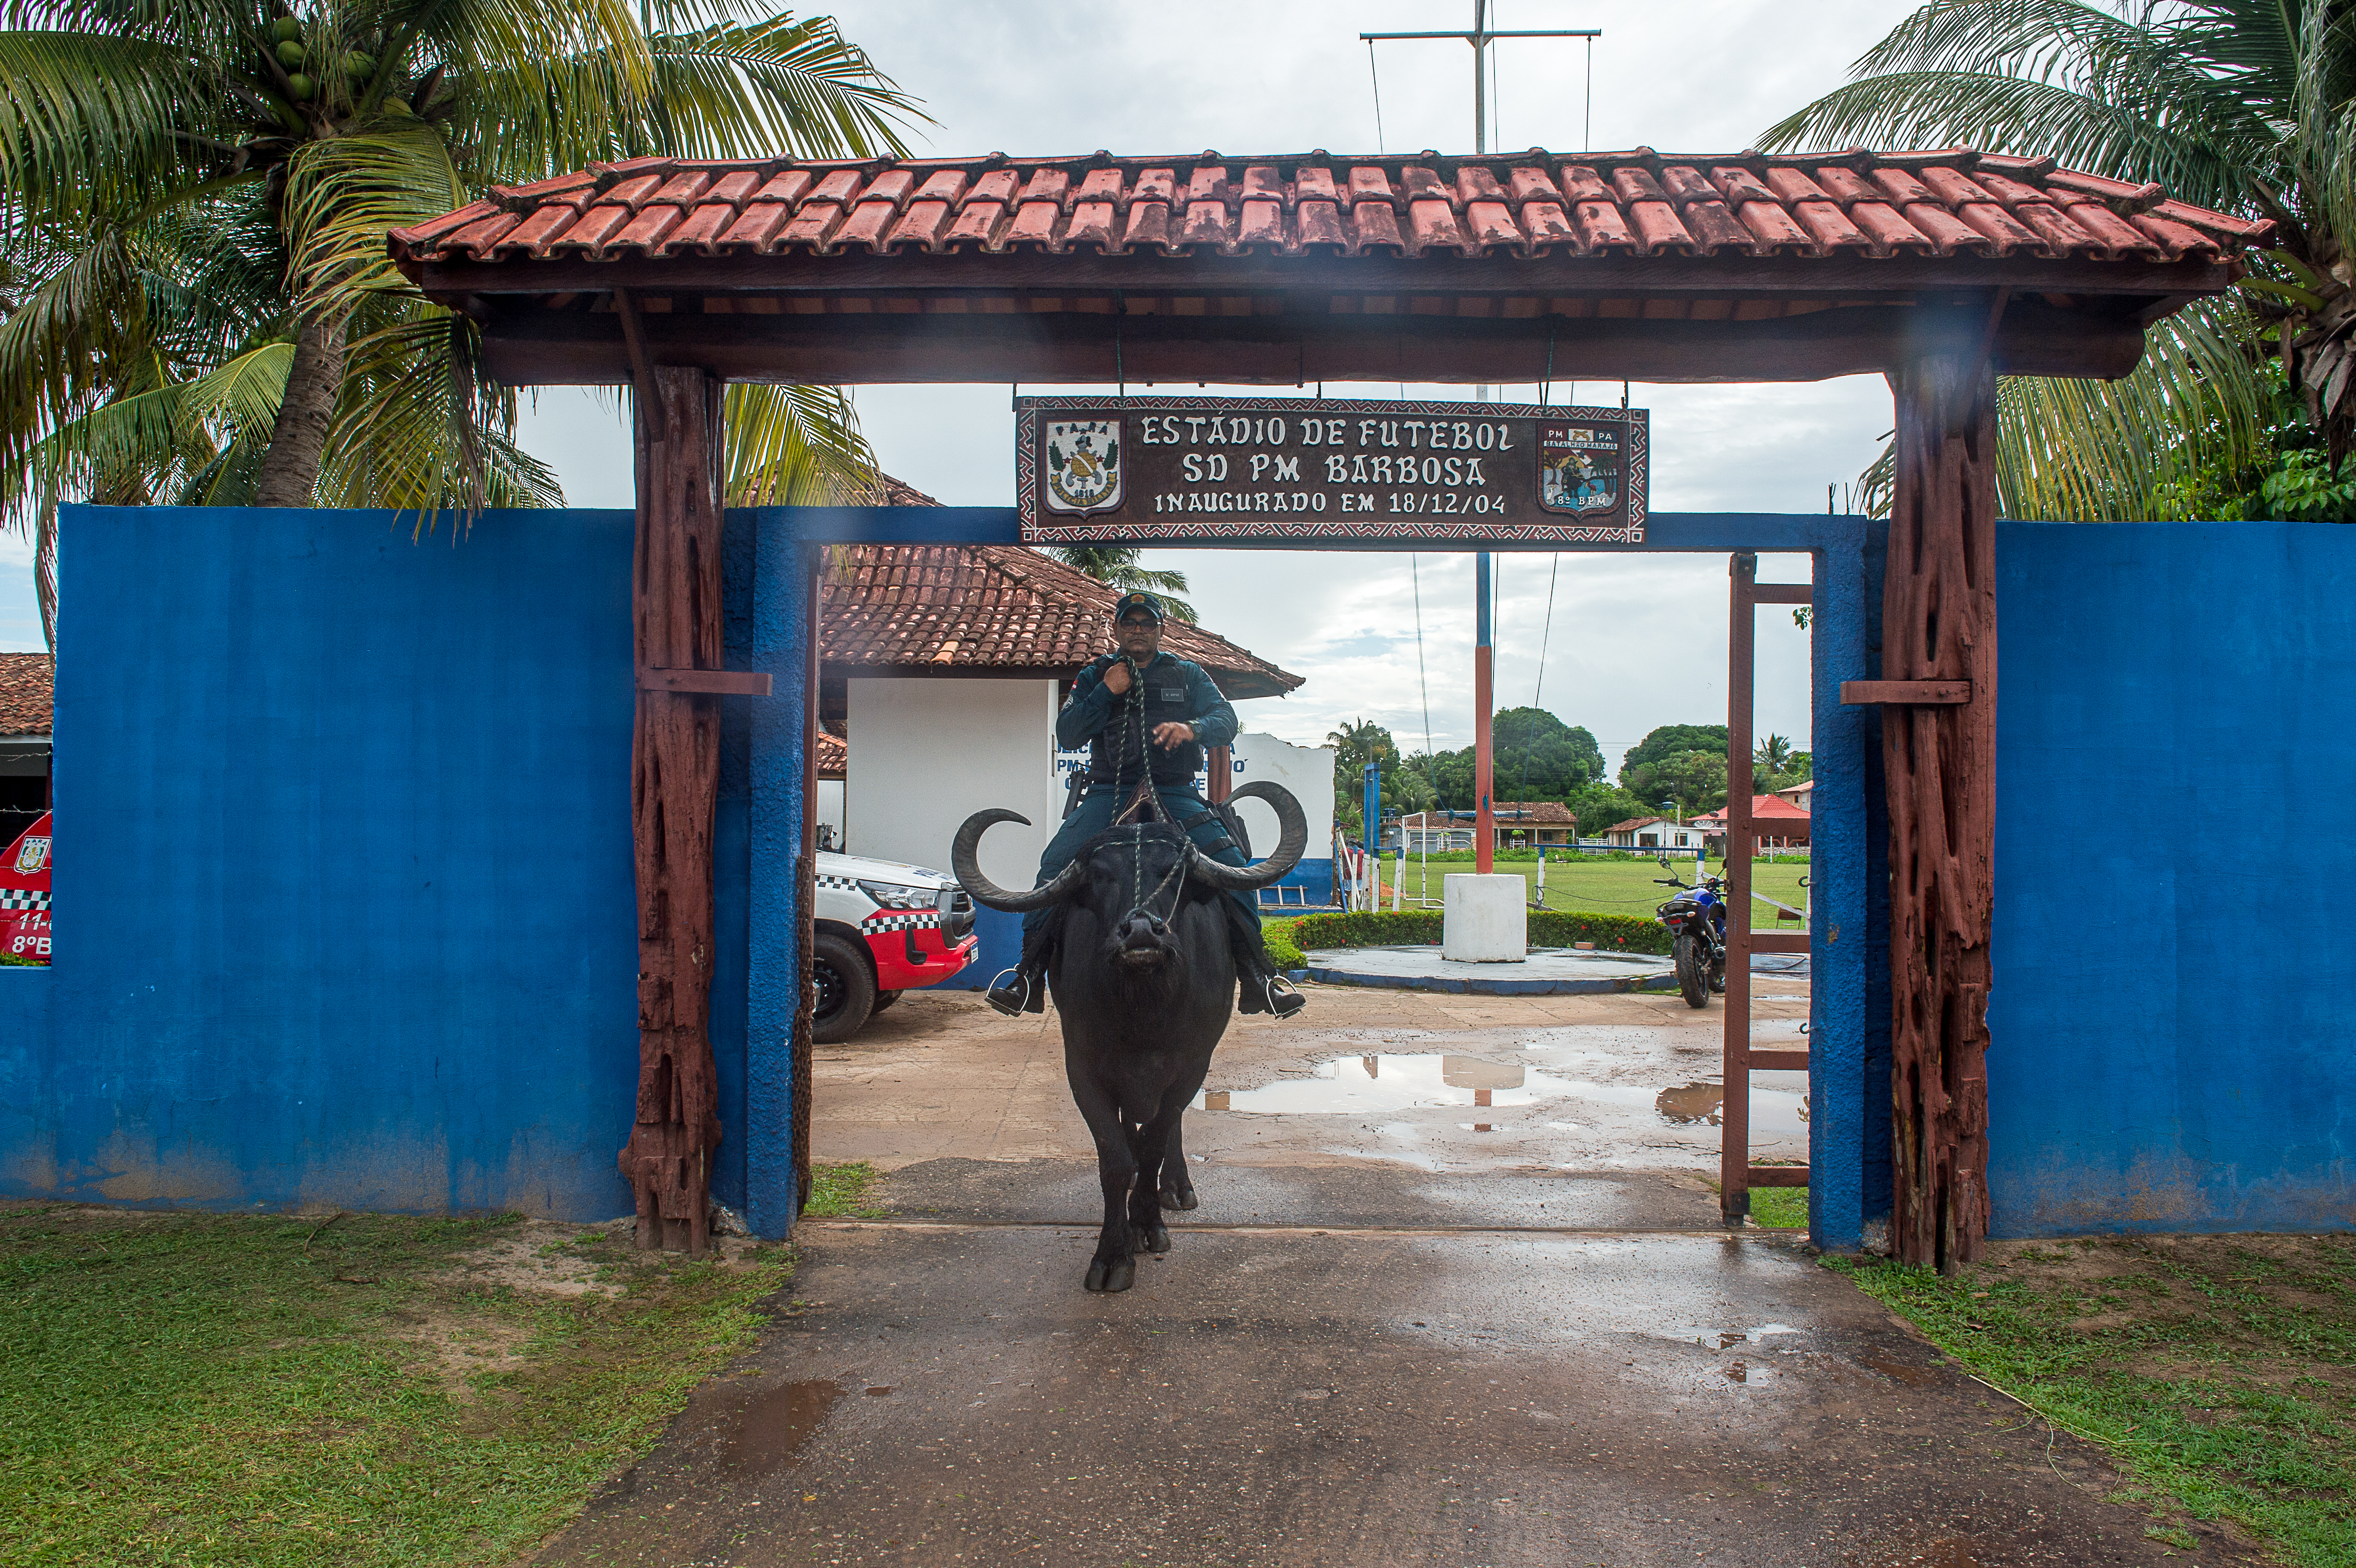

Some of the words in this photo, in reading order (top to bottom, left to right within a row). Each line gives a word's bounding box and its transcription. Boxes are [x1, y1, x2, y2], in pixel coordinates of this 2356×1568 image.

[1056, 421, 1109, 436] PARÁ
[1141, 411, 1286, 445] ESTÁDIO
[1300, 419, 1346, 445] DE
[1359, 419, 1514, 451] FUTEBOL
[1183, 454, 1228, 481] SD
[1250, 454, 1300, 481] PM
[1324, 455, 1486, 486] BARBOSA
[1075, 489, 1094, 498] 1818
[1579, 497, 1606, 507] BPM
[1155, 492, 1326, 512] INAUGURADO
[1341, 493, 1374, 512] EM
[1389, 493, 1505, 514] 18/12/04
